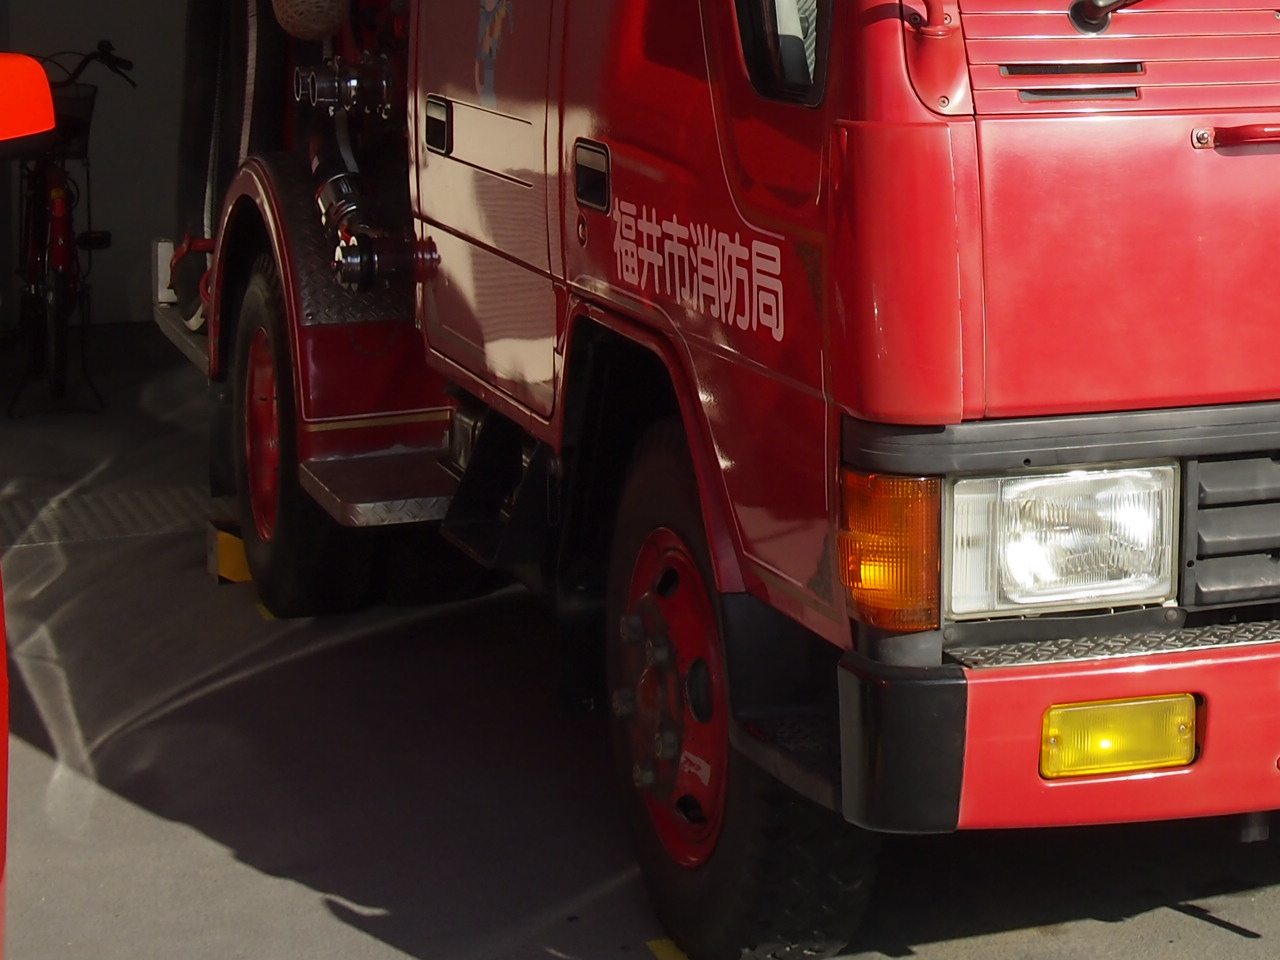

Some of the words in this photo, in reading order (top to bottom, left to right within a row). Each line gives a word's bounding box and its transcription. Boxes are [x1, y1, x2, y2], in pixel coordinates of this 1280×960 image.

[613, 197, 785, 342] 福井市消防局
